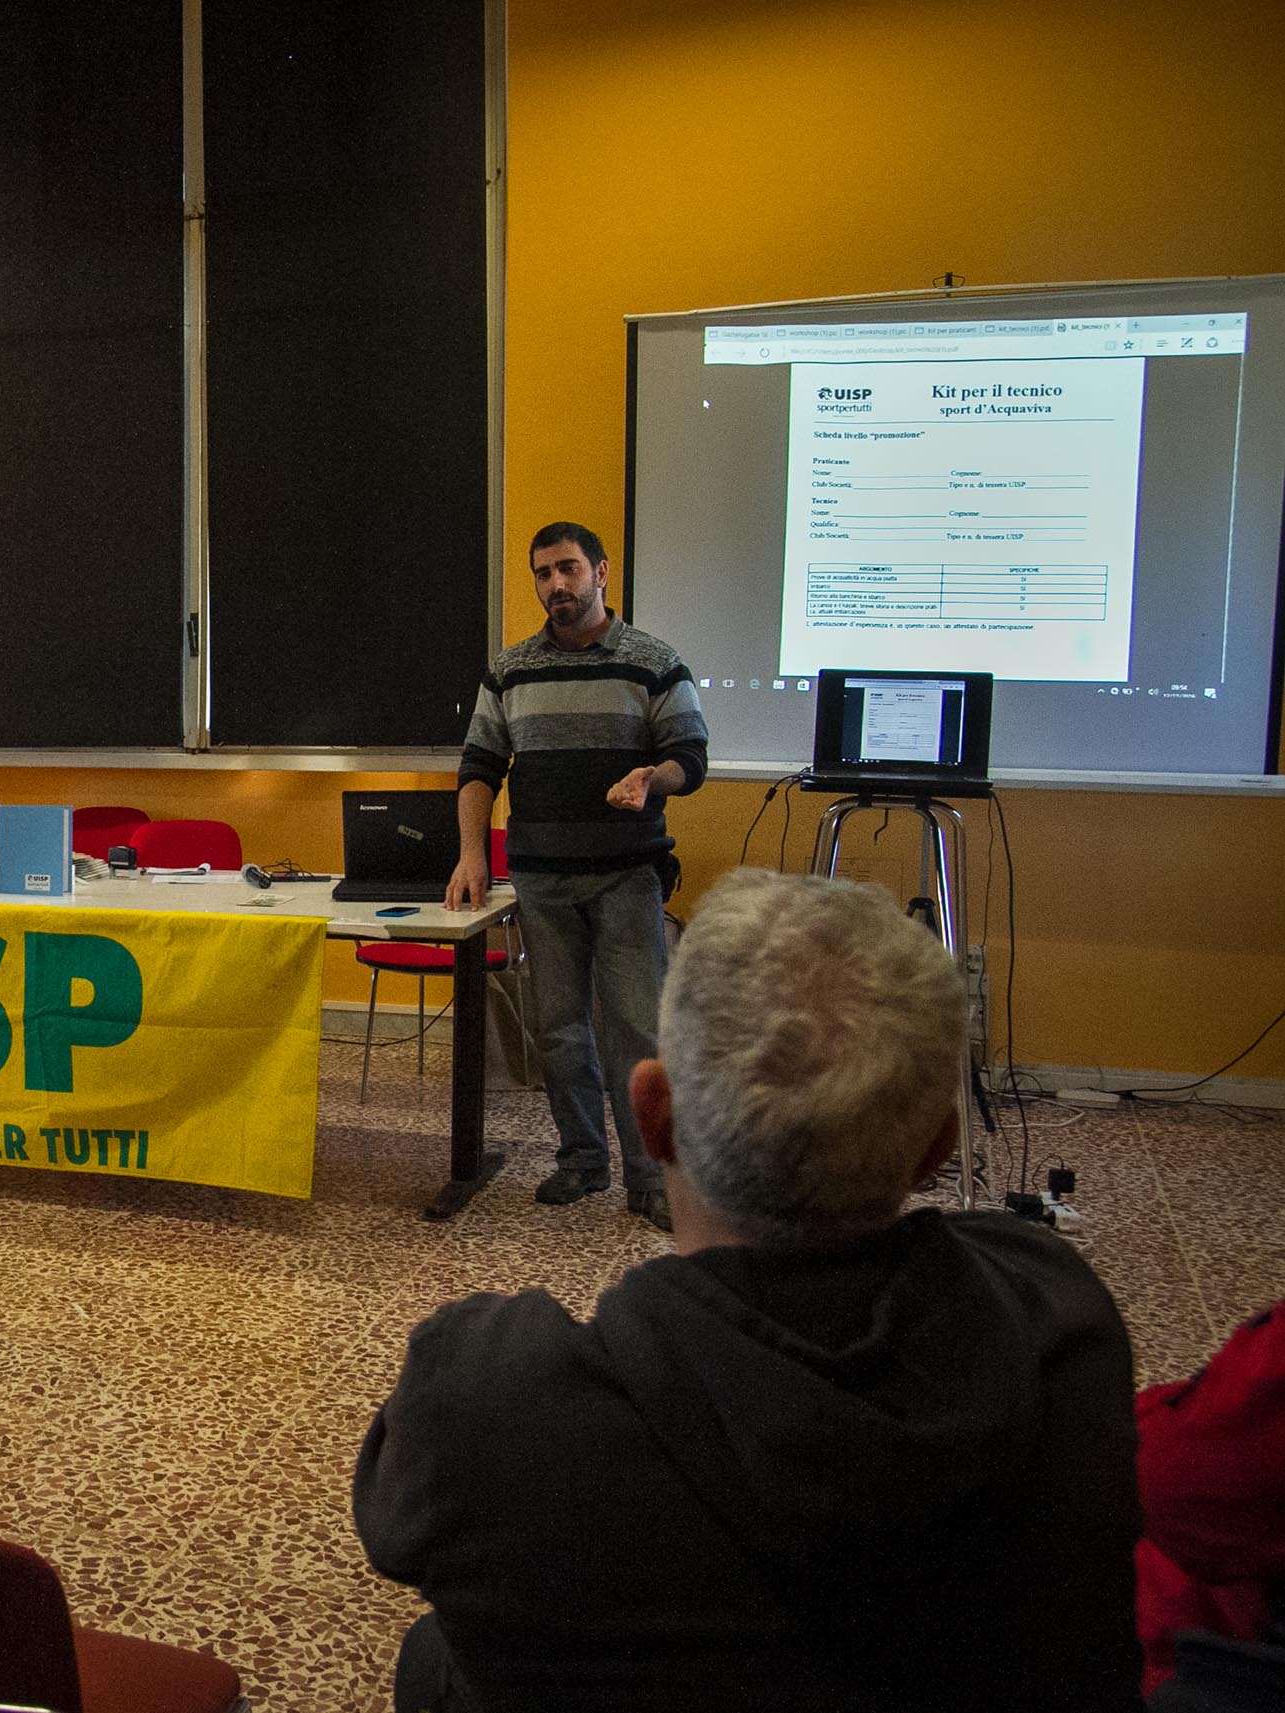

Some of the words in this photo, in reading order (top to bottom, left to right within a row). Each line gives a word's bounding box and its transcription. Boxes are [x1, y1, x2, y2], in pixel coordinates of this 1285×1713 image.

[834, 388, 873, 401] UISP
[932, 384, 957, 399] Kit
[961, 387, 988, 402] per
[992, 383, 1002, 398] il
[1007, 383, 1063, 398] tecnico
[939, 404, 971, 417] sport
[814, 431, 842, 439] Scheda
[844, 431, 868, 439] livello
[812, 457, 850, 465] Praticante
[811, 497, 838, 505] Tecnico
[41, 1126, 149, 1171] TUTTI
